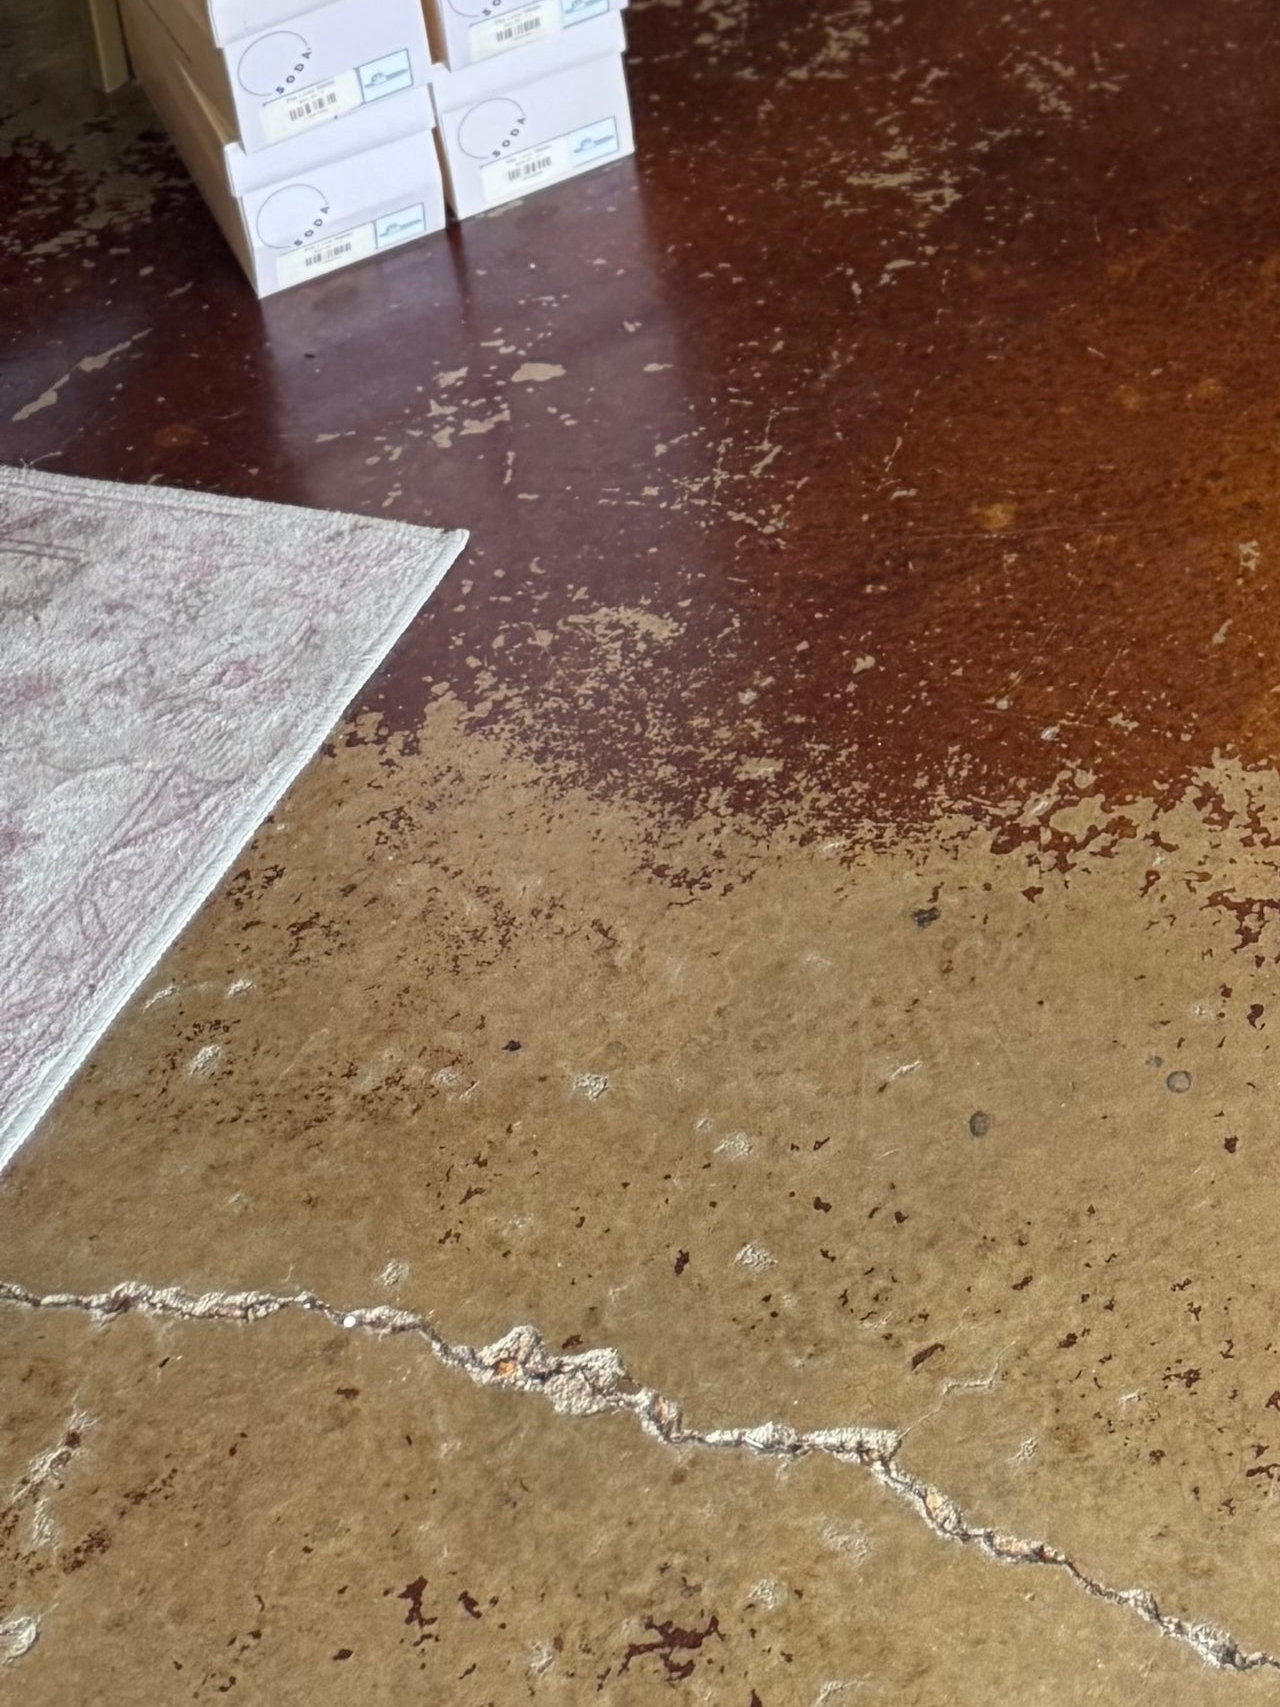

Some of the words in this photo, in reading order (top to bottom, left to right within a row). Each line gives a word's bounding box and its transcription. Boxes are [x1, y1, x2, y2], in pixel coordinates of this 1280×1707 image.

[276, 50, 312, 94] SODA
[492, 117, 527, 158] SODA
[293, 205, 330, 247] SODA
